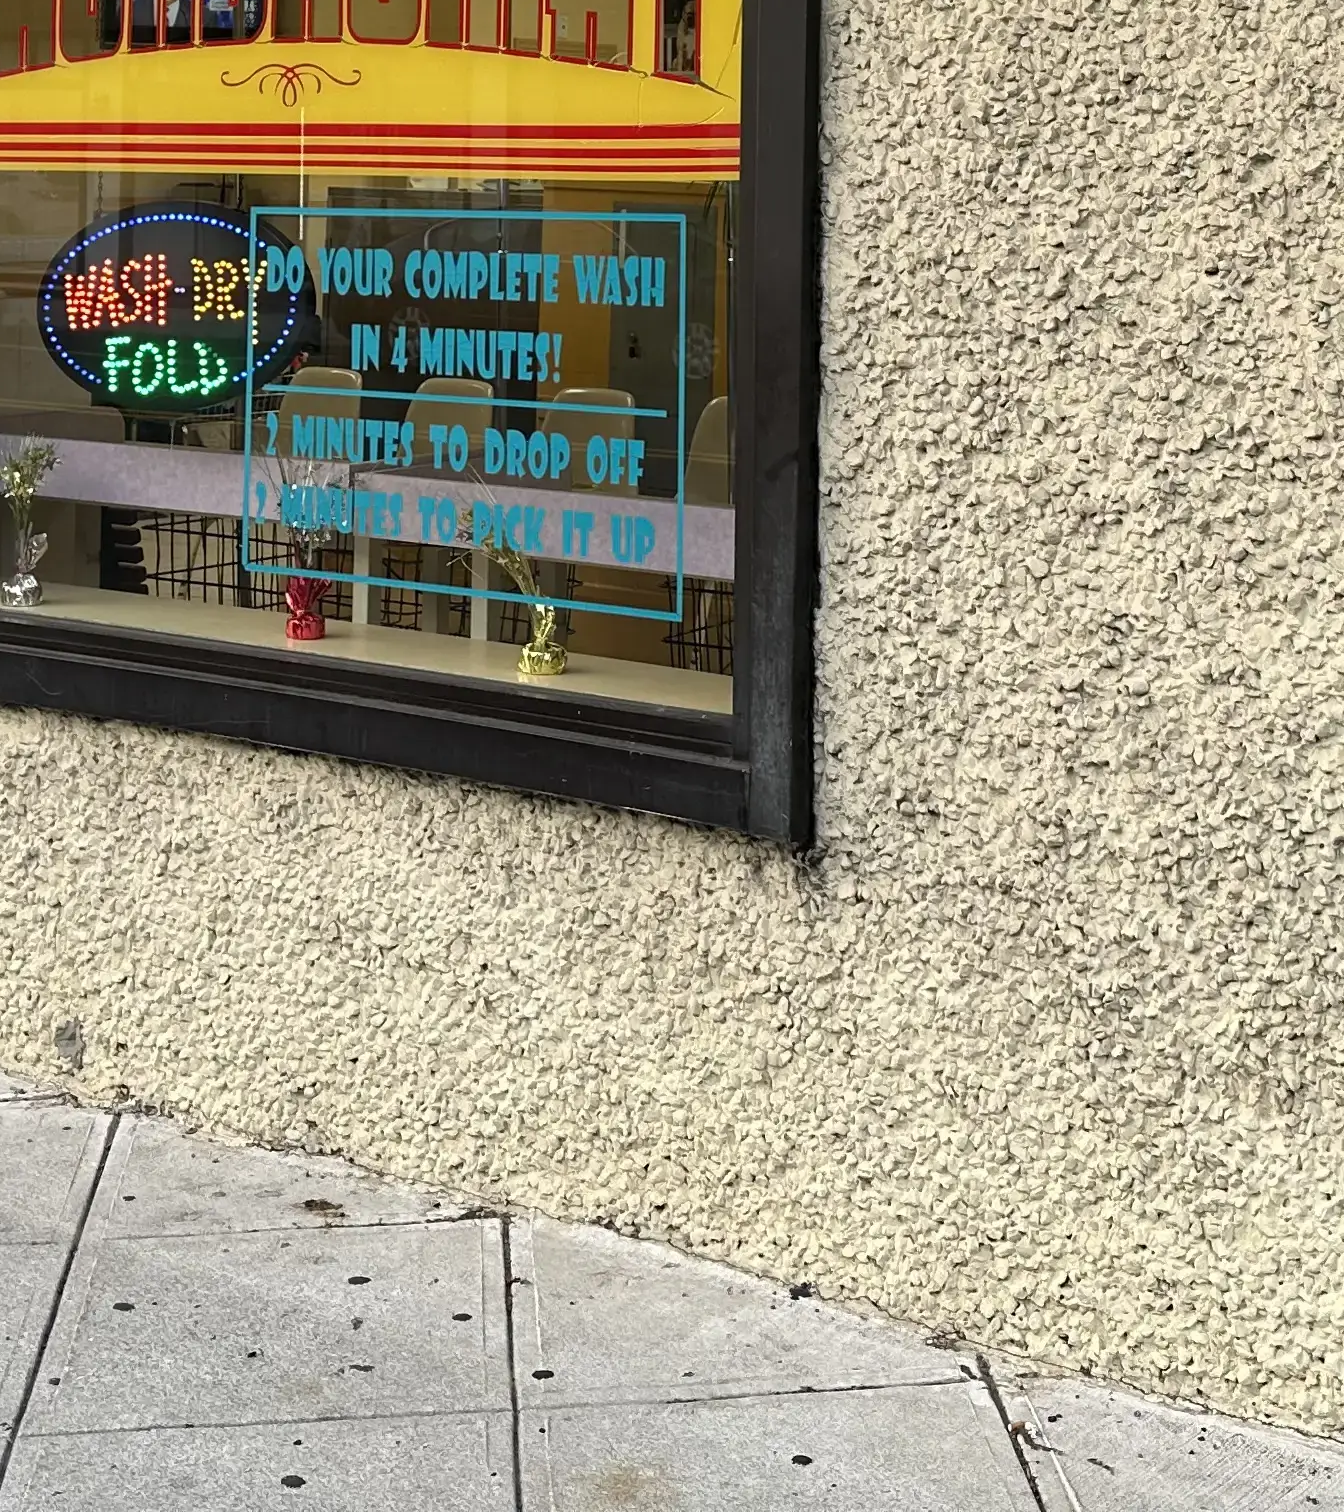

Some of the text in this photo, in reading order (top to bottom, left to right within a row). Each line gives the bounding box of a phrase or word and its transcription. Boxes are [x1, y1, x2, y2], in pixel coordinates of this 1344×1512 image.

[266, 245, 666, 308] DO YOUR COMPLETE WASH
[103, 336, 228, 395] FOLD
[351, 323, 563, 384] IN 4 MINUTES!
[266, 412, 646, 487] 2 MINUTES TO DROP OFF
[256, 481, 656, 565] 2 MINUTES TO PICK IT UP
